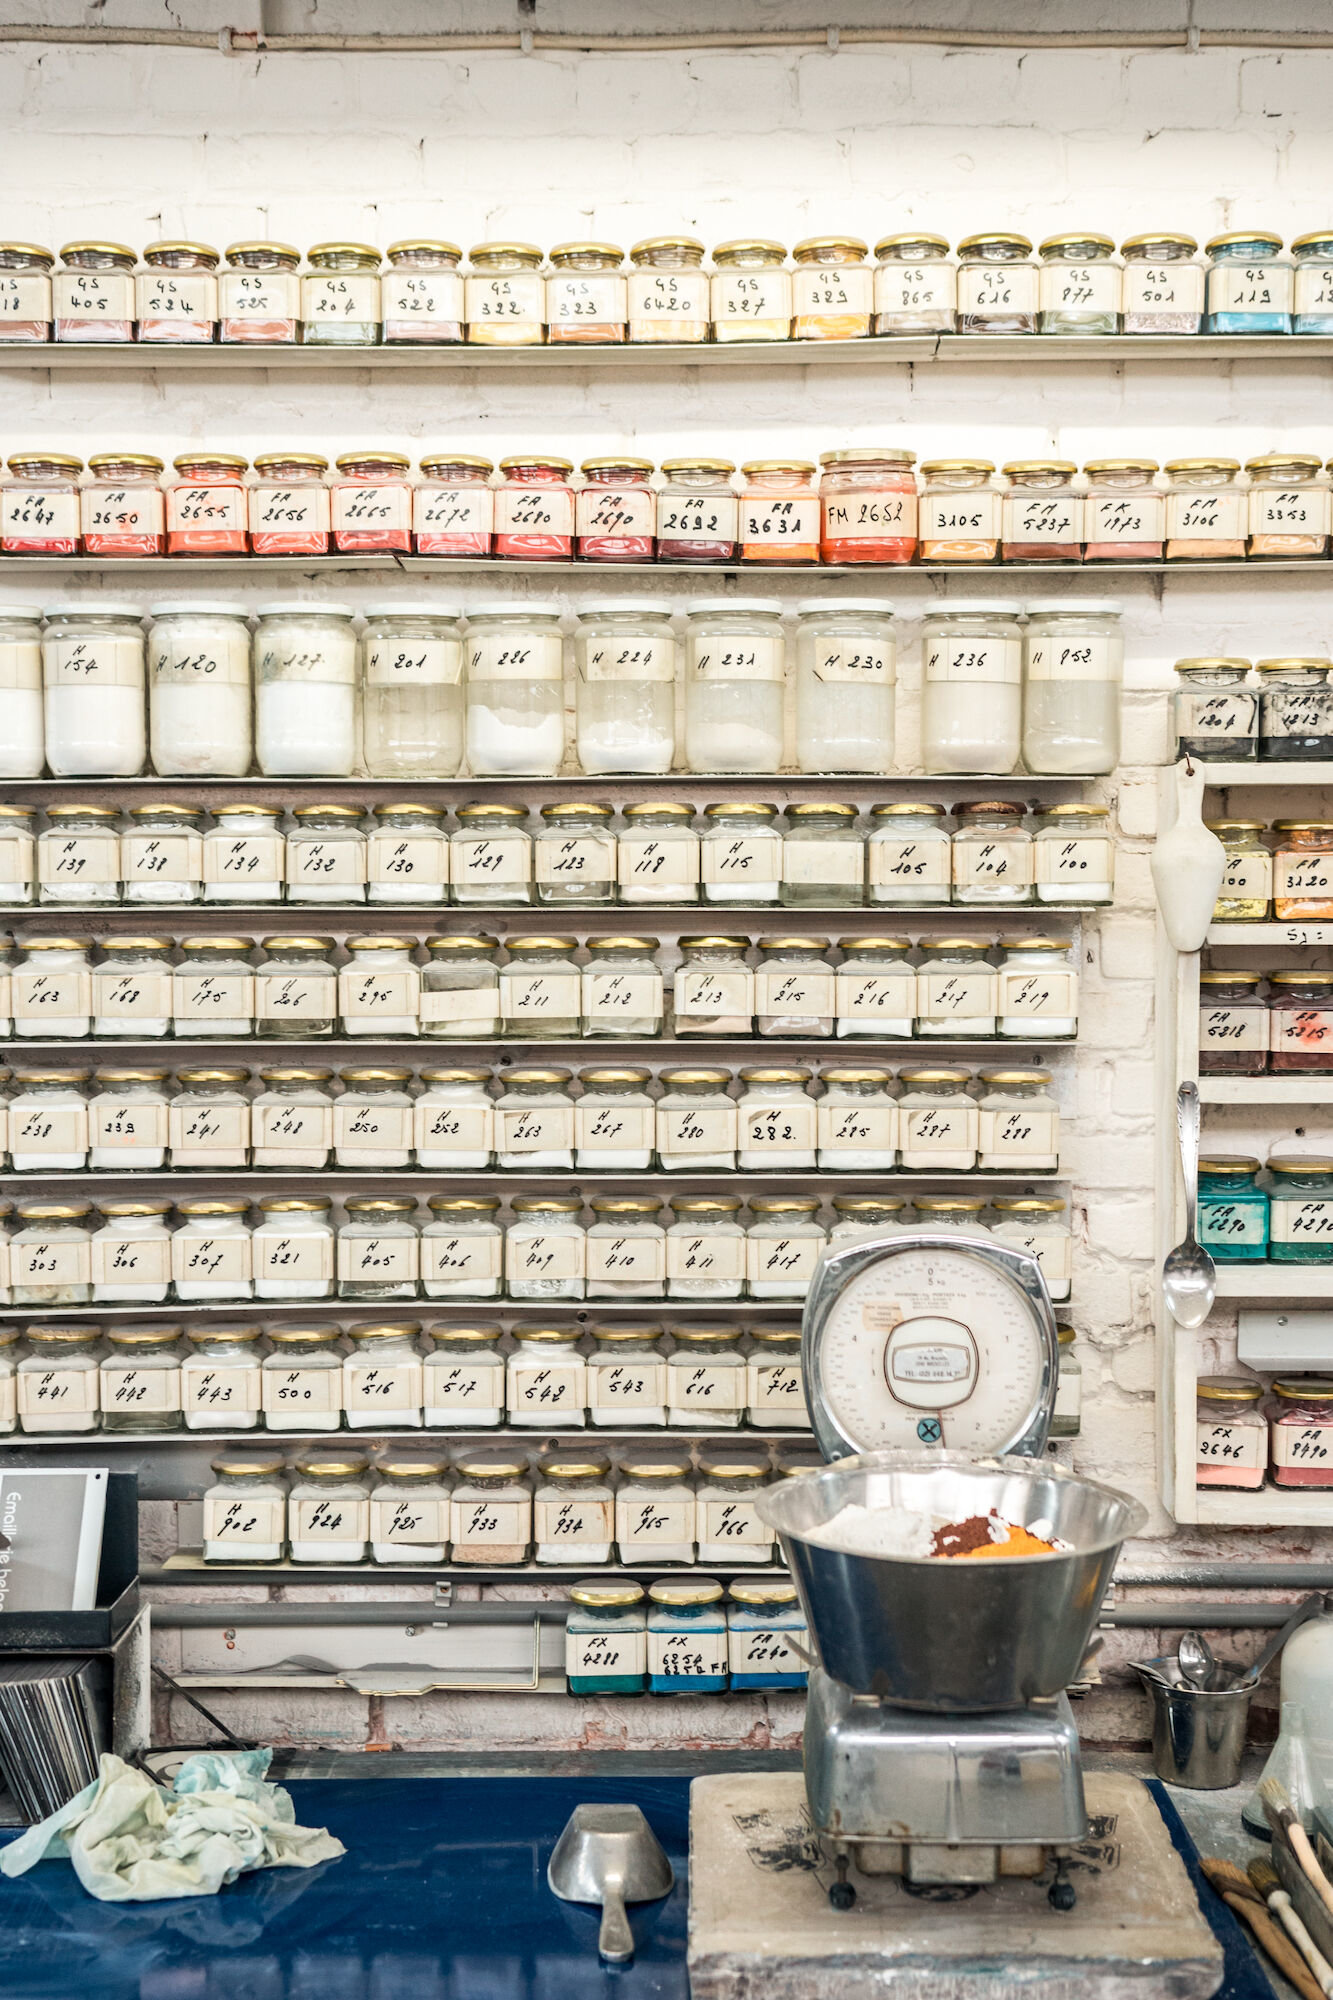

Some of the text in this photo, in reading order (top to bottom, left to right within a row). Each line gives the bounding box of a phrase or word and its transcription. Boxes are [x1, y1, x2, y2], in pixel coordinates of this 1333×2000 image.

[71, 296, 109, 310] 405
[643, 296, 691, 311] 6420
[811, 290, 848, 304] 329
[901, 290, 934, 306] 865
[976, 290, 1011, 305] 616
[1142, 290, 1175, 303] 501
[1233, 289, 1271, 304] 119
[148, 298, 194, 314] 524
[316, 298, 356, 316] 204
[397, 298, 435, 312] 522
[482, 301, 521, 316] 322
[559, 301, 598, 316] 323
[728, 299, 766, 317] 327
[92, 511, 138, 524] 2650
[180, 505, 230, 519] 2655
[261, 507, 308, 522] 2656
[344, 504, 392, 518] 2665
[424, 508, 471, 529] 2672
[828, 501, 903, 524] FM 2652
[1267, 509, 1306, 521] 3353
[590, 511, 634, 533] 2690
[937, 513, 983, 528] 3105
[1023, 518, 1071, 534] 5237
[1182, 512, 1219, 527] 3106
[173, 654, 217, 674] 120
[394, 653, 427, 669] 201
[497, 650, 531, 666] 226
[616, 650, 652, 666] 224
[721, 652, 755, 666] 231
[847, 655, 883, 670] 230
[952, 652, 987, 667] 236
[64, 658, 99, 675] 154
[56, 858, 87, 875] 139
[223, 856, 260, 873] 134
[303, 858, 336, 872] 132
[386, 858, 414, 873] 130
[468, 854, 504, 872] 129
[553, 856, 585, 871] 123
[720, 856, 753, 869] 115
[890, 862, 927, 875] 105
[975, 860, 1007, 877] 104
[1059, 859, 1088, 870] 100
[28, 991, 60, 1004] 163
[191, 990, 227, 1008] 175
[517, 994, 549, 1007] 211
[598, 992, 632, 1006] 212
[690, 991, 723, 1004] 213
[773, 990, 806, 1002] 215
[853, 991, 890, 1006] 216
[935, 991, 968, 1009] 217
[1014, 991, 1049, 1013] 219
[21, 1124, 52, 1138] 238
[104, 1122, 135, 1134] 239
[270, 1120, 303, 1135] 248
[349, 1122, 378, 1133] 250
[430, 1122, 459, 1135] 252
[513, 1125, 542, 1139] 263
[590, 1122, 623, 1139] 267
[29, 1259, 57, 1272] 303
[112, 1256, 138, 1268] 306
[188, 1254, 224, 1274] 307
[270, 1252, 300, 1265] 321
[361, 1254, 396, 1269] 405
[604, 1253, 635, 1269] 410
[685, 1255, 714, 1269] 411
[766, 1253, 801, 1270] 417
[37, 1385, 69, 1400] 441
[278, 1387, 312, 1399] 500
[361, 1381, 395, 1395] 516
[442, 1380, 477, 1397] 517
[524, 1384, 566, 1403] 542
[608, 1379, 644, 1394] 543
[685, 1383, 715, 1396] 616
[766, 1379, 799, 1396] 712
[115, 1386, 147, 1403] 442
[197, 1386, 233, 1404] 443
[1199, 1441, 1244, 1459] 2646
[216, 1517, 257, 1537] 902
[467, 1517, 498, 1534] 933
[553, 1518, 583, 1535] 934
